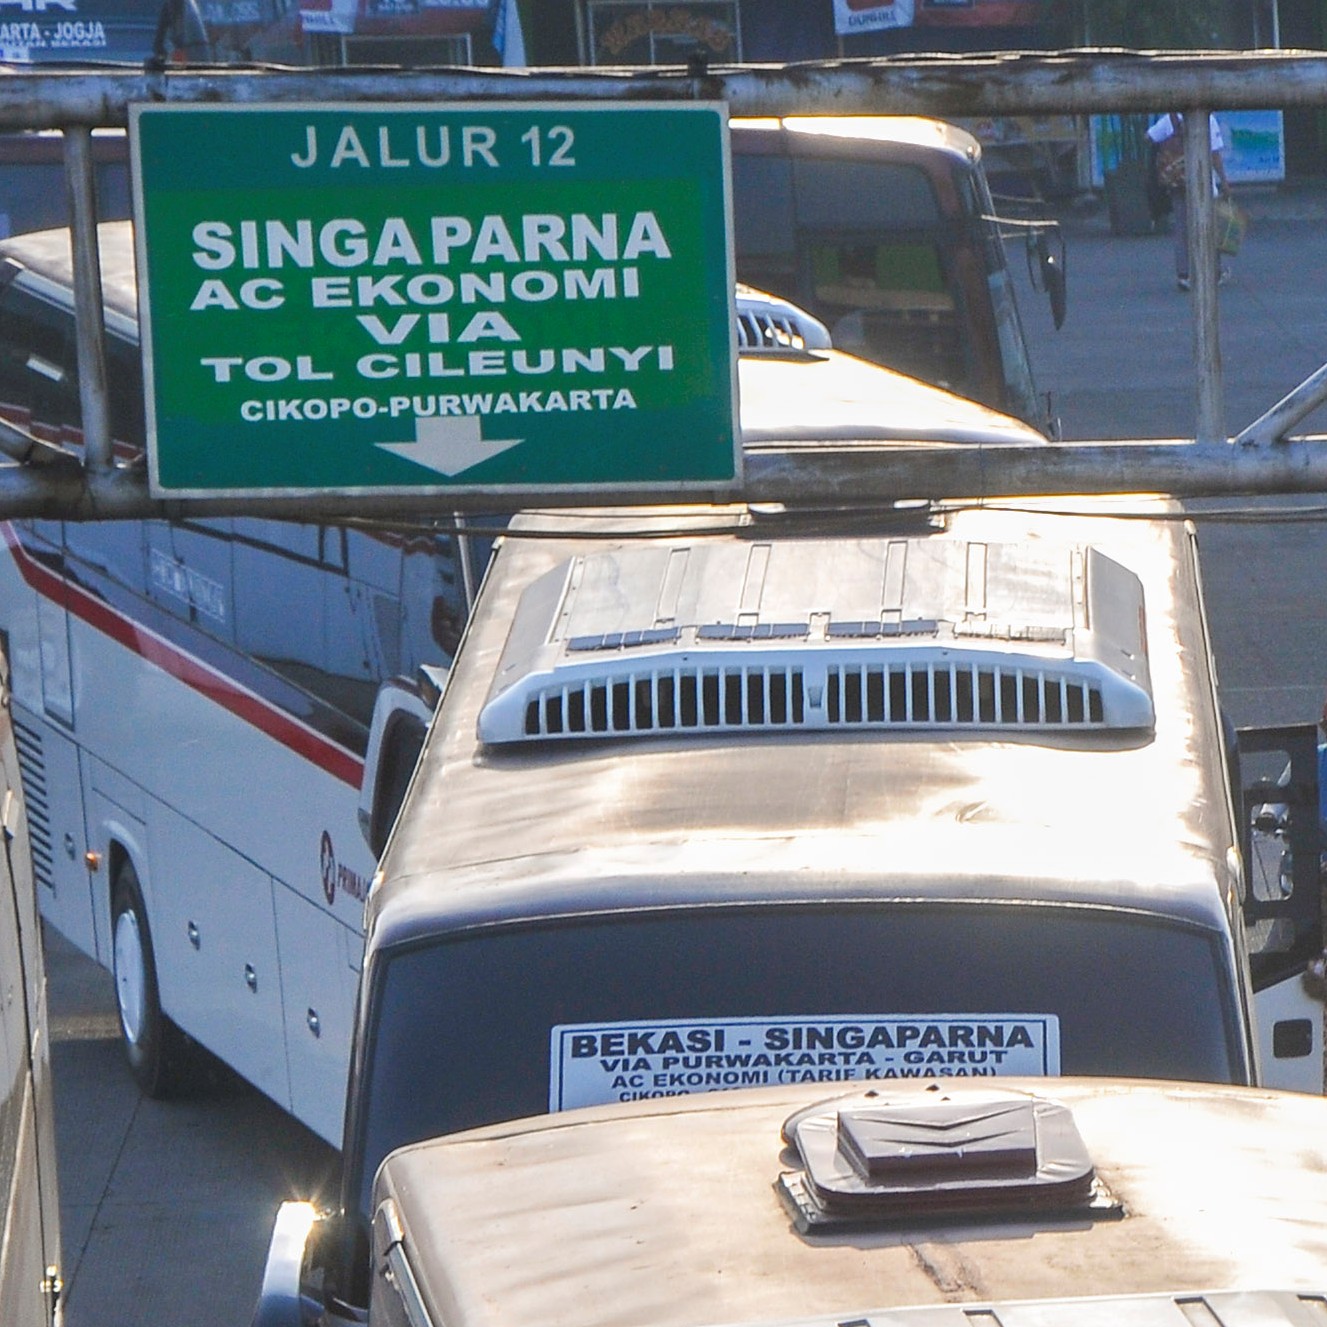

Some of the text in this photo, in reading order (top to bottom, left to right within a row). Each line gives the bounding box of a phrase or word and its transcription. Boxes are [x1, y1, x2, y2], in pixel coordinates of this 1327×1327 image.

[291, 124, 576, 168] JALUR 12
[192, 211, 672, 270] SINGAPARNA
[190, 266, 640, 310] AC EKONOMI
[356, 310, 522, 345] VIA
[200, 344, 675, 383] TOL CILEUNYI
[240, 388, 637, 422] CIKOPO-PURWAKARTA
[571, 1028, 725, 1059] BEKASI
[763, 1025, 1035, 1051] SINGAPARNA
[599, 1057, 652, 1073] VIA
[662, 1051, 874, 1070] PURWAKARTA
[903, 1049, 1008, 1065] GARUT
[611, 1066, 997, 1089] AC EKONOMI (TARIF KAWASAN)
